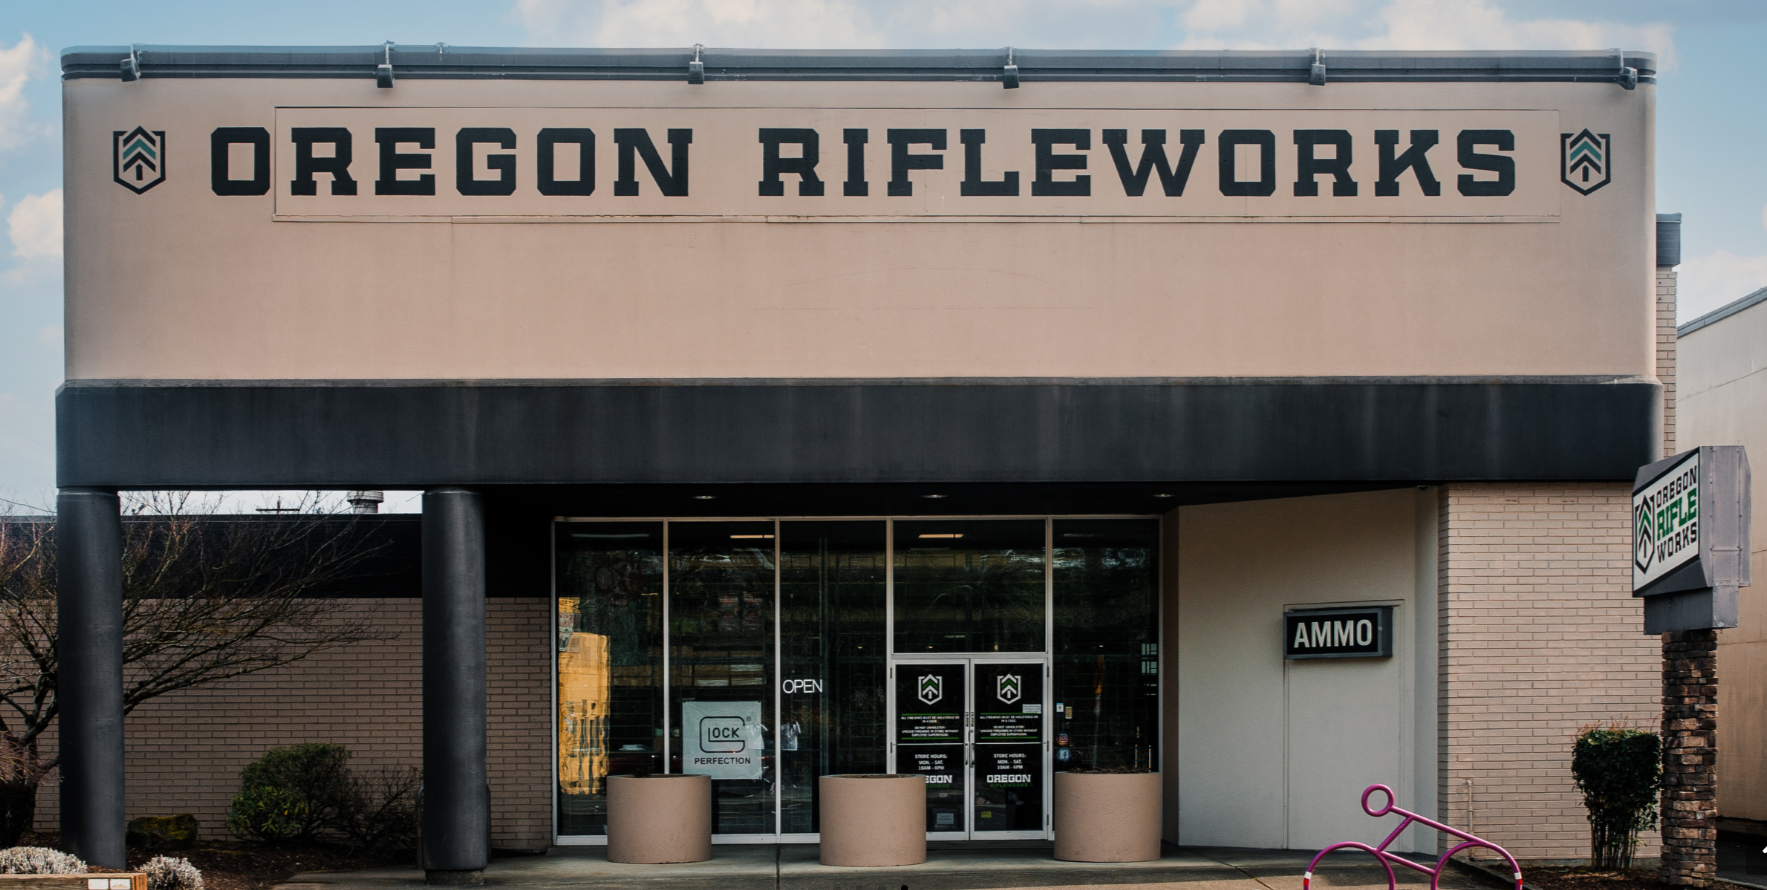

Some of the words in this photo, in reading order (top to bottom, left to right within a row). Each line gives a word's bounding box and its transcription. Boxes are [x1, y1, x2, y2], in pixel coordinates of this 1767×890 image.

[211, 126, 693, 197] OREGON
[758, 128, 1517, 197] RIFLEWORKS
[1656, 465, 1697, 509] OREGON
[1656, 487, 1697, 541] RIFLE
[1657, 521, 1697, 563] WORKS
[1294, 619, 1372, 648] AMMO
[782, 679, 823, 693] OPEN
[926, 775, 952, 783] EGON
[987, 775, 1031, 783] OREGON
